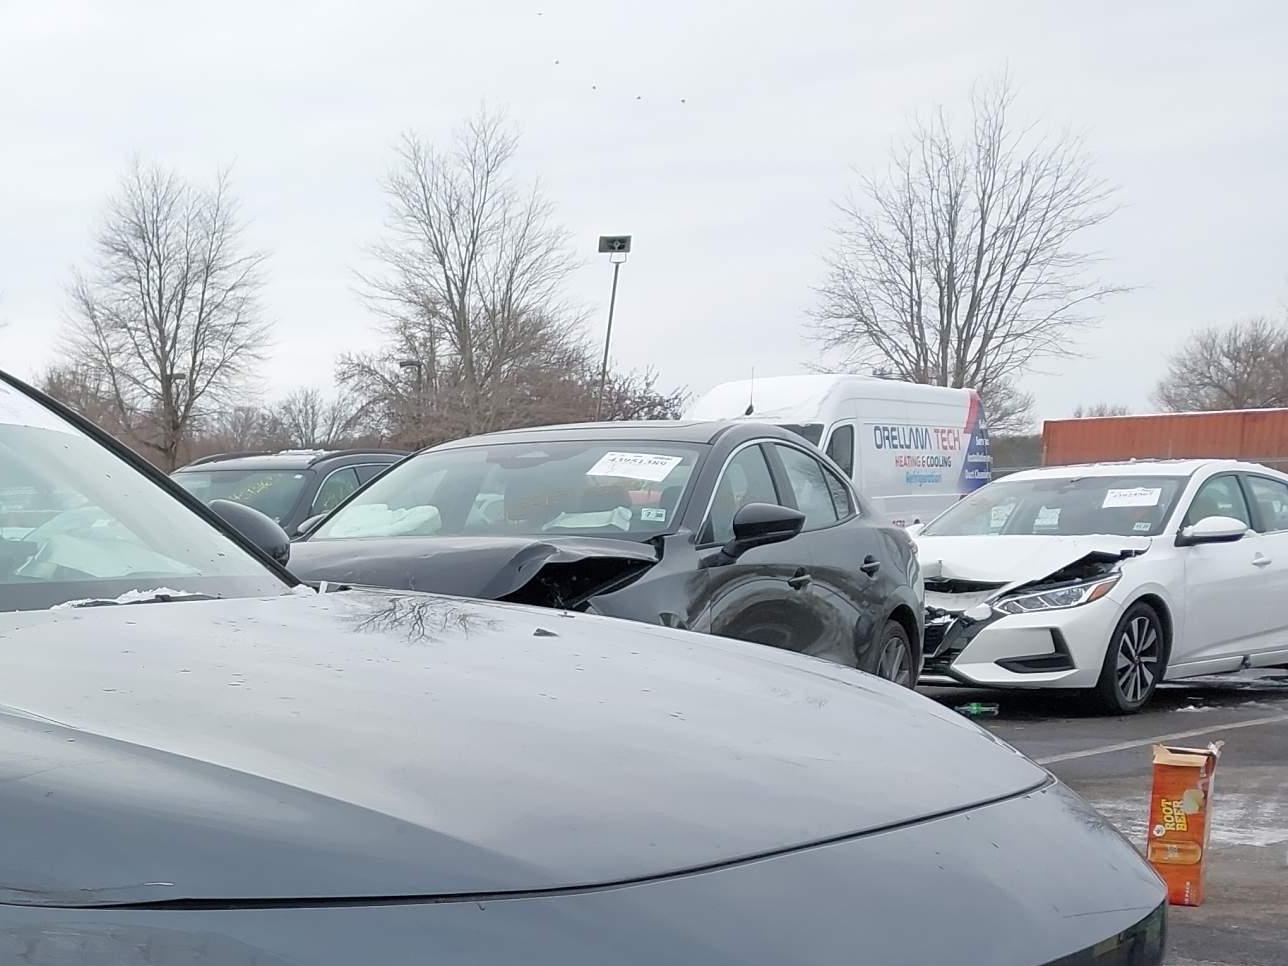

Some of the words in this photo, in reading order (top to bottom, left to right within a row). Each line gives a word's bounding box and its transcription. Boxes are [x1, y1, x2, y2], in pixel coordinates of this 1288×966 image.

[874, 426, 932, 449] ORELLANA
[934, 429, 960, 450] TECH
[895, 455, 920, 467] HEATING
[927, 455, 951, 467] COOLING
[1161, 799, 1175, 831] ROOT
[1173, 800, 1187, 832] BEER
